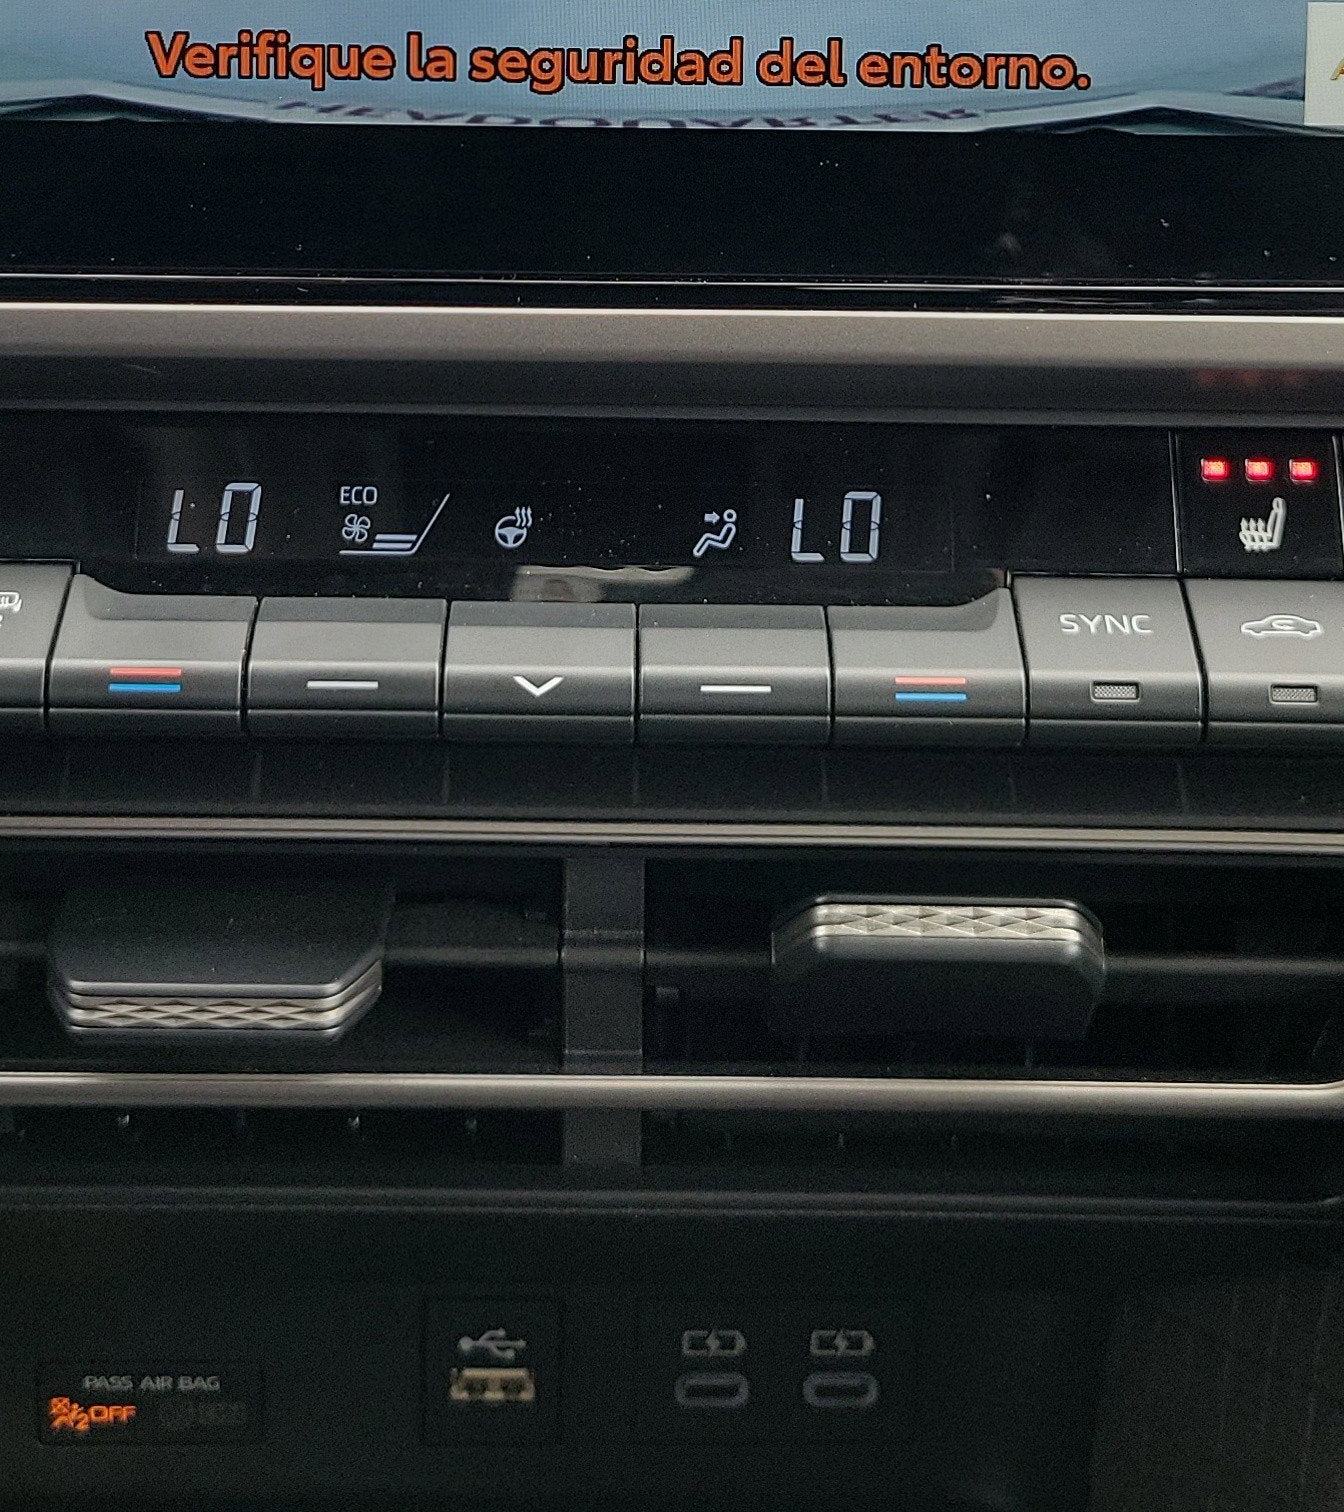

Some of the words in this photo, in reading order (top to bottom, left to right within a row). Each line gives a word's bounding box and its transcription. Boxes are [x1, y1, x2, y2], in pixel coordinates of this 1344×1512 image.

[145, 29, 396, 90] Verifique
[407, 31, 457, 81] la
[467, 34, 744, 94] seguridad
[756, 36, 847, 87] del
[857, 43, 1092, 90] entorno.
[339, 486, 378, 506] ECO
[166, 482, 261, 554] LO
[791, 491, 882, 564] LO
[1059, 613, 1153, 635] SYNC
[82, 1375, 133, 1389] PASS
[140, 1375, 173, 1389] AIR
[178, 1375, 220, 1389] BAG
[89, 1405, 138, 1422] OFF
